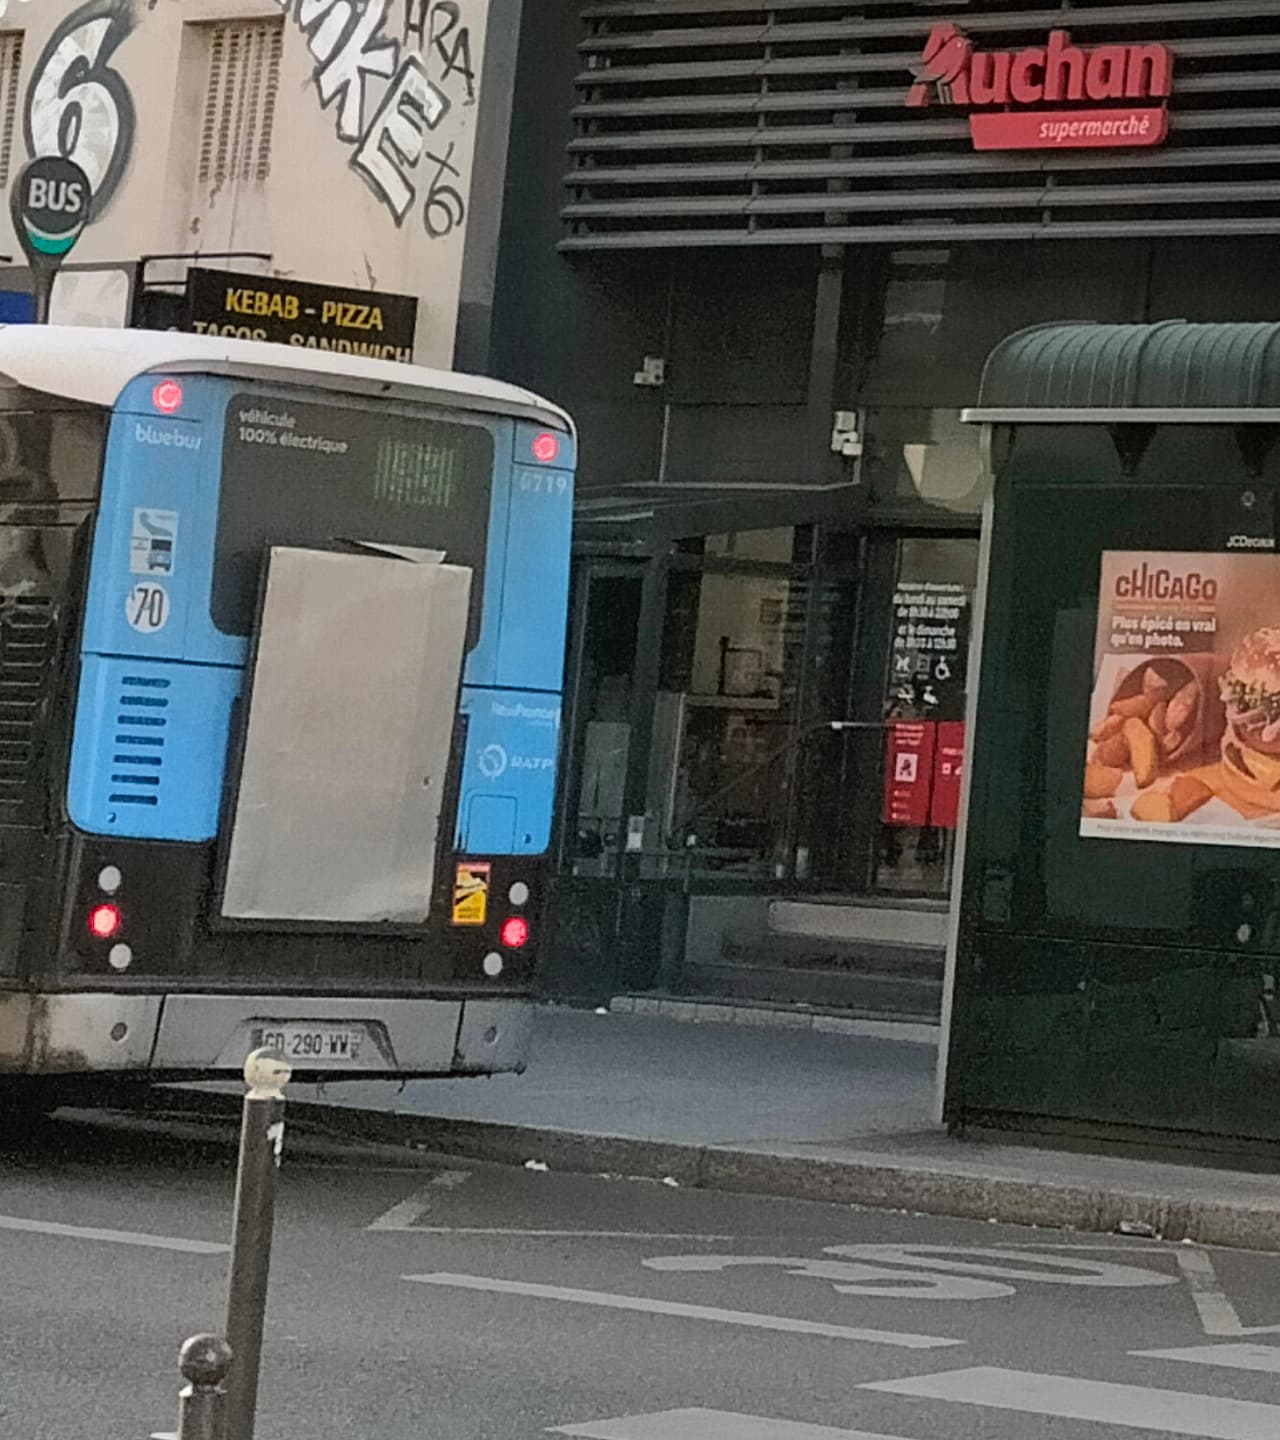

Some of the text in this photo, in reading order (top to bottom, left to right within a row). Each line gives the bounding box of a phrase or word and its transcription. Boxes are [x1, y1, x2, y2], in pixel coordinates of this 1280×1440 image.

[905, 21, 1173, 107] Auchan
[1039, 114, 1150, 143] supermarché
[27, 178, 82, 212] BUS
[225, 287, 300, 320] KEBAB
[321, 300, 384, 332] PIZZA
[238, 427, 278, 447] 100%
[133, 587, 165, 628] 70
[1112, 615, 1138, 630] Plus
[1192, 616, 1217, 632] vrai
